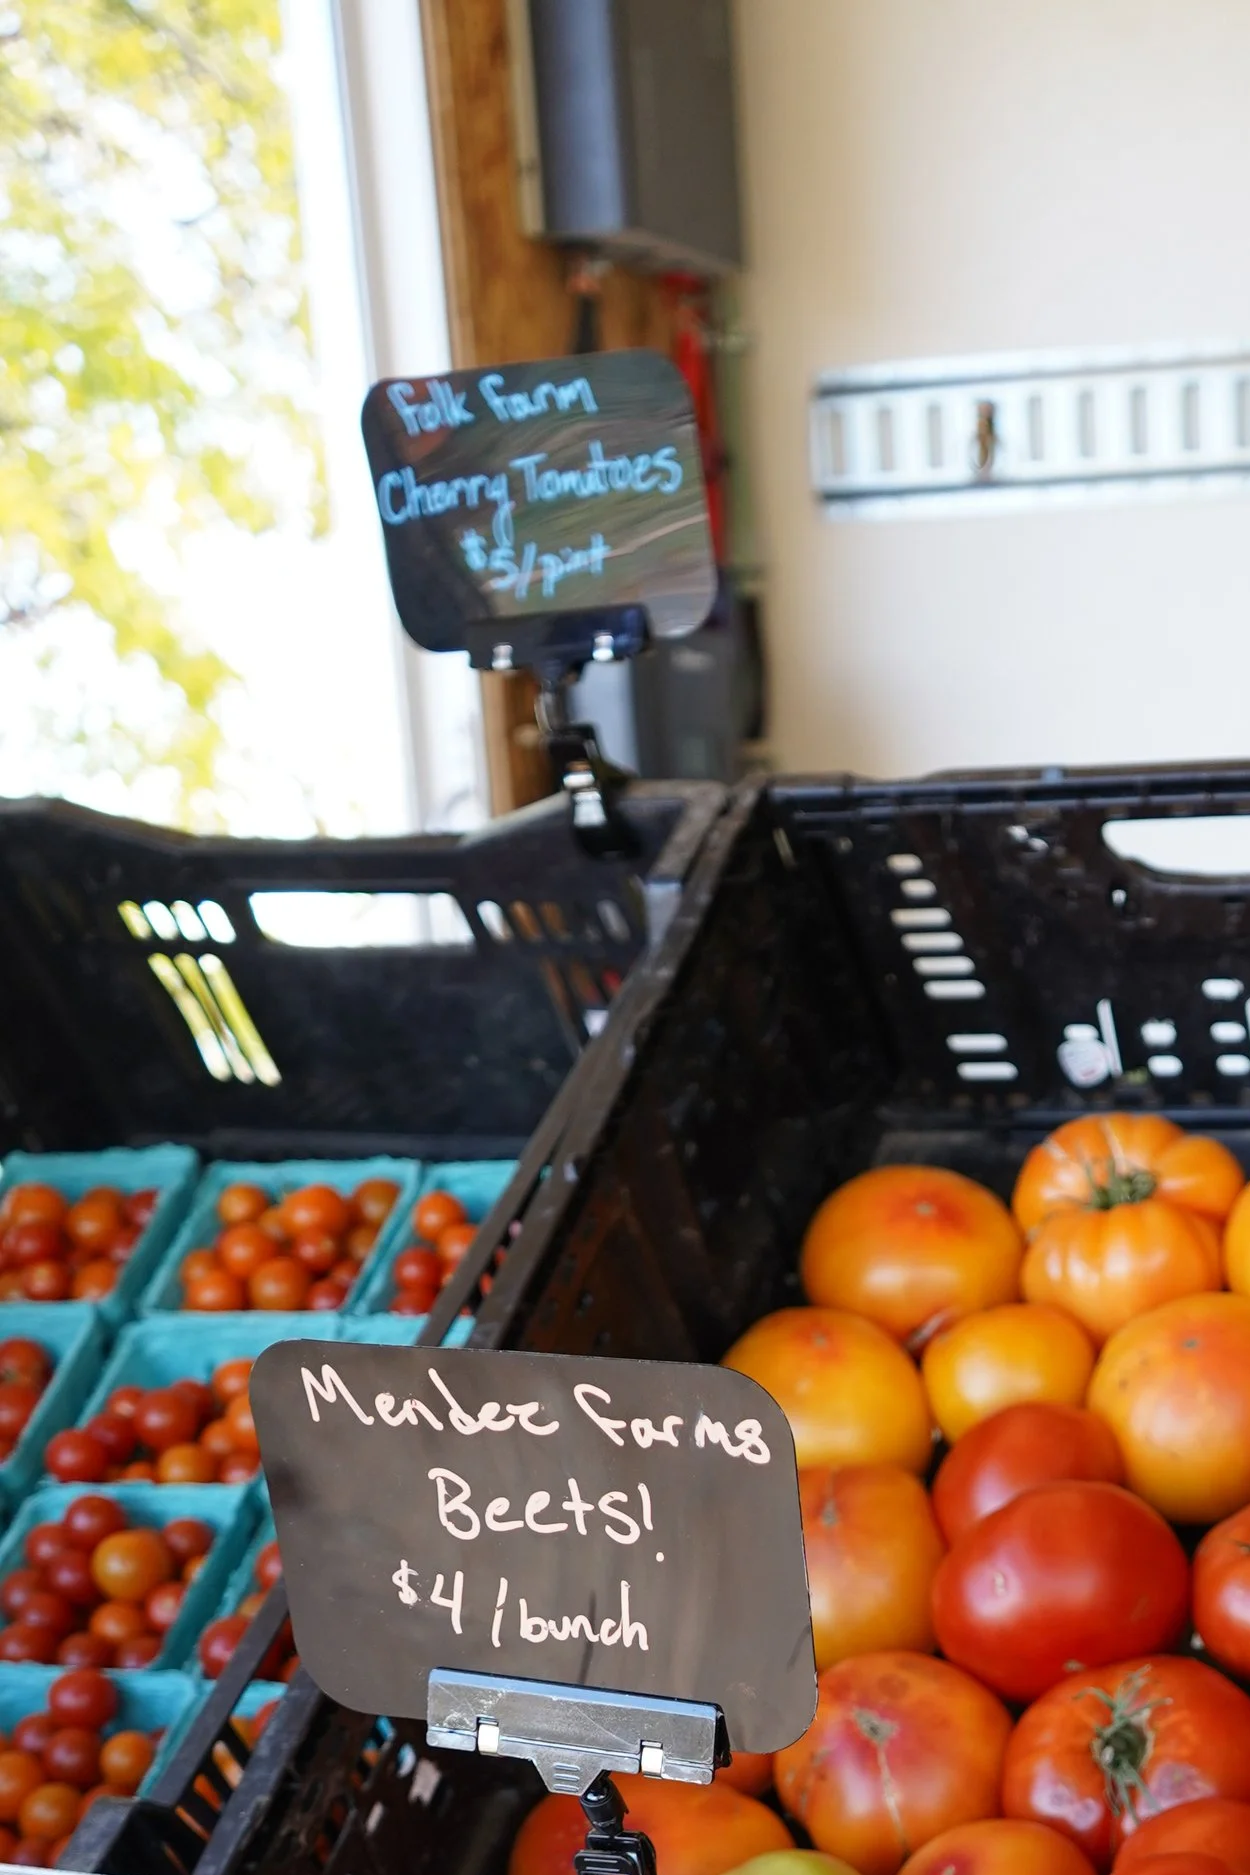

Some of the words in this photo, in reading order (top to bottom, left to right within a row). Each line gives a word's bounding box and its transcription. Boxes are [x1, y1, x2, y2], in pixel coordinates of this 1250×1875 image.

[378, 466, 516, 550] Cherry
[509, 440, 684, 502] Tomatoes
[427, 1468, 666, 1562] Beets!
